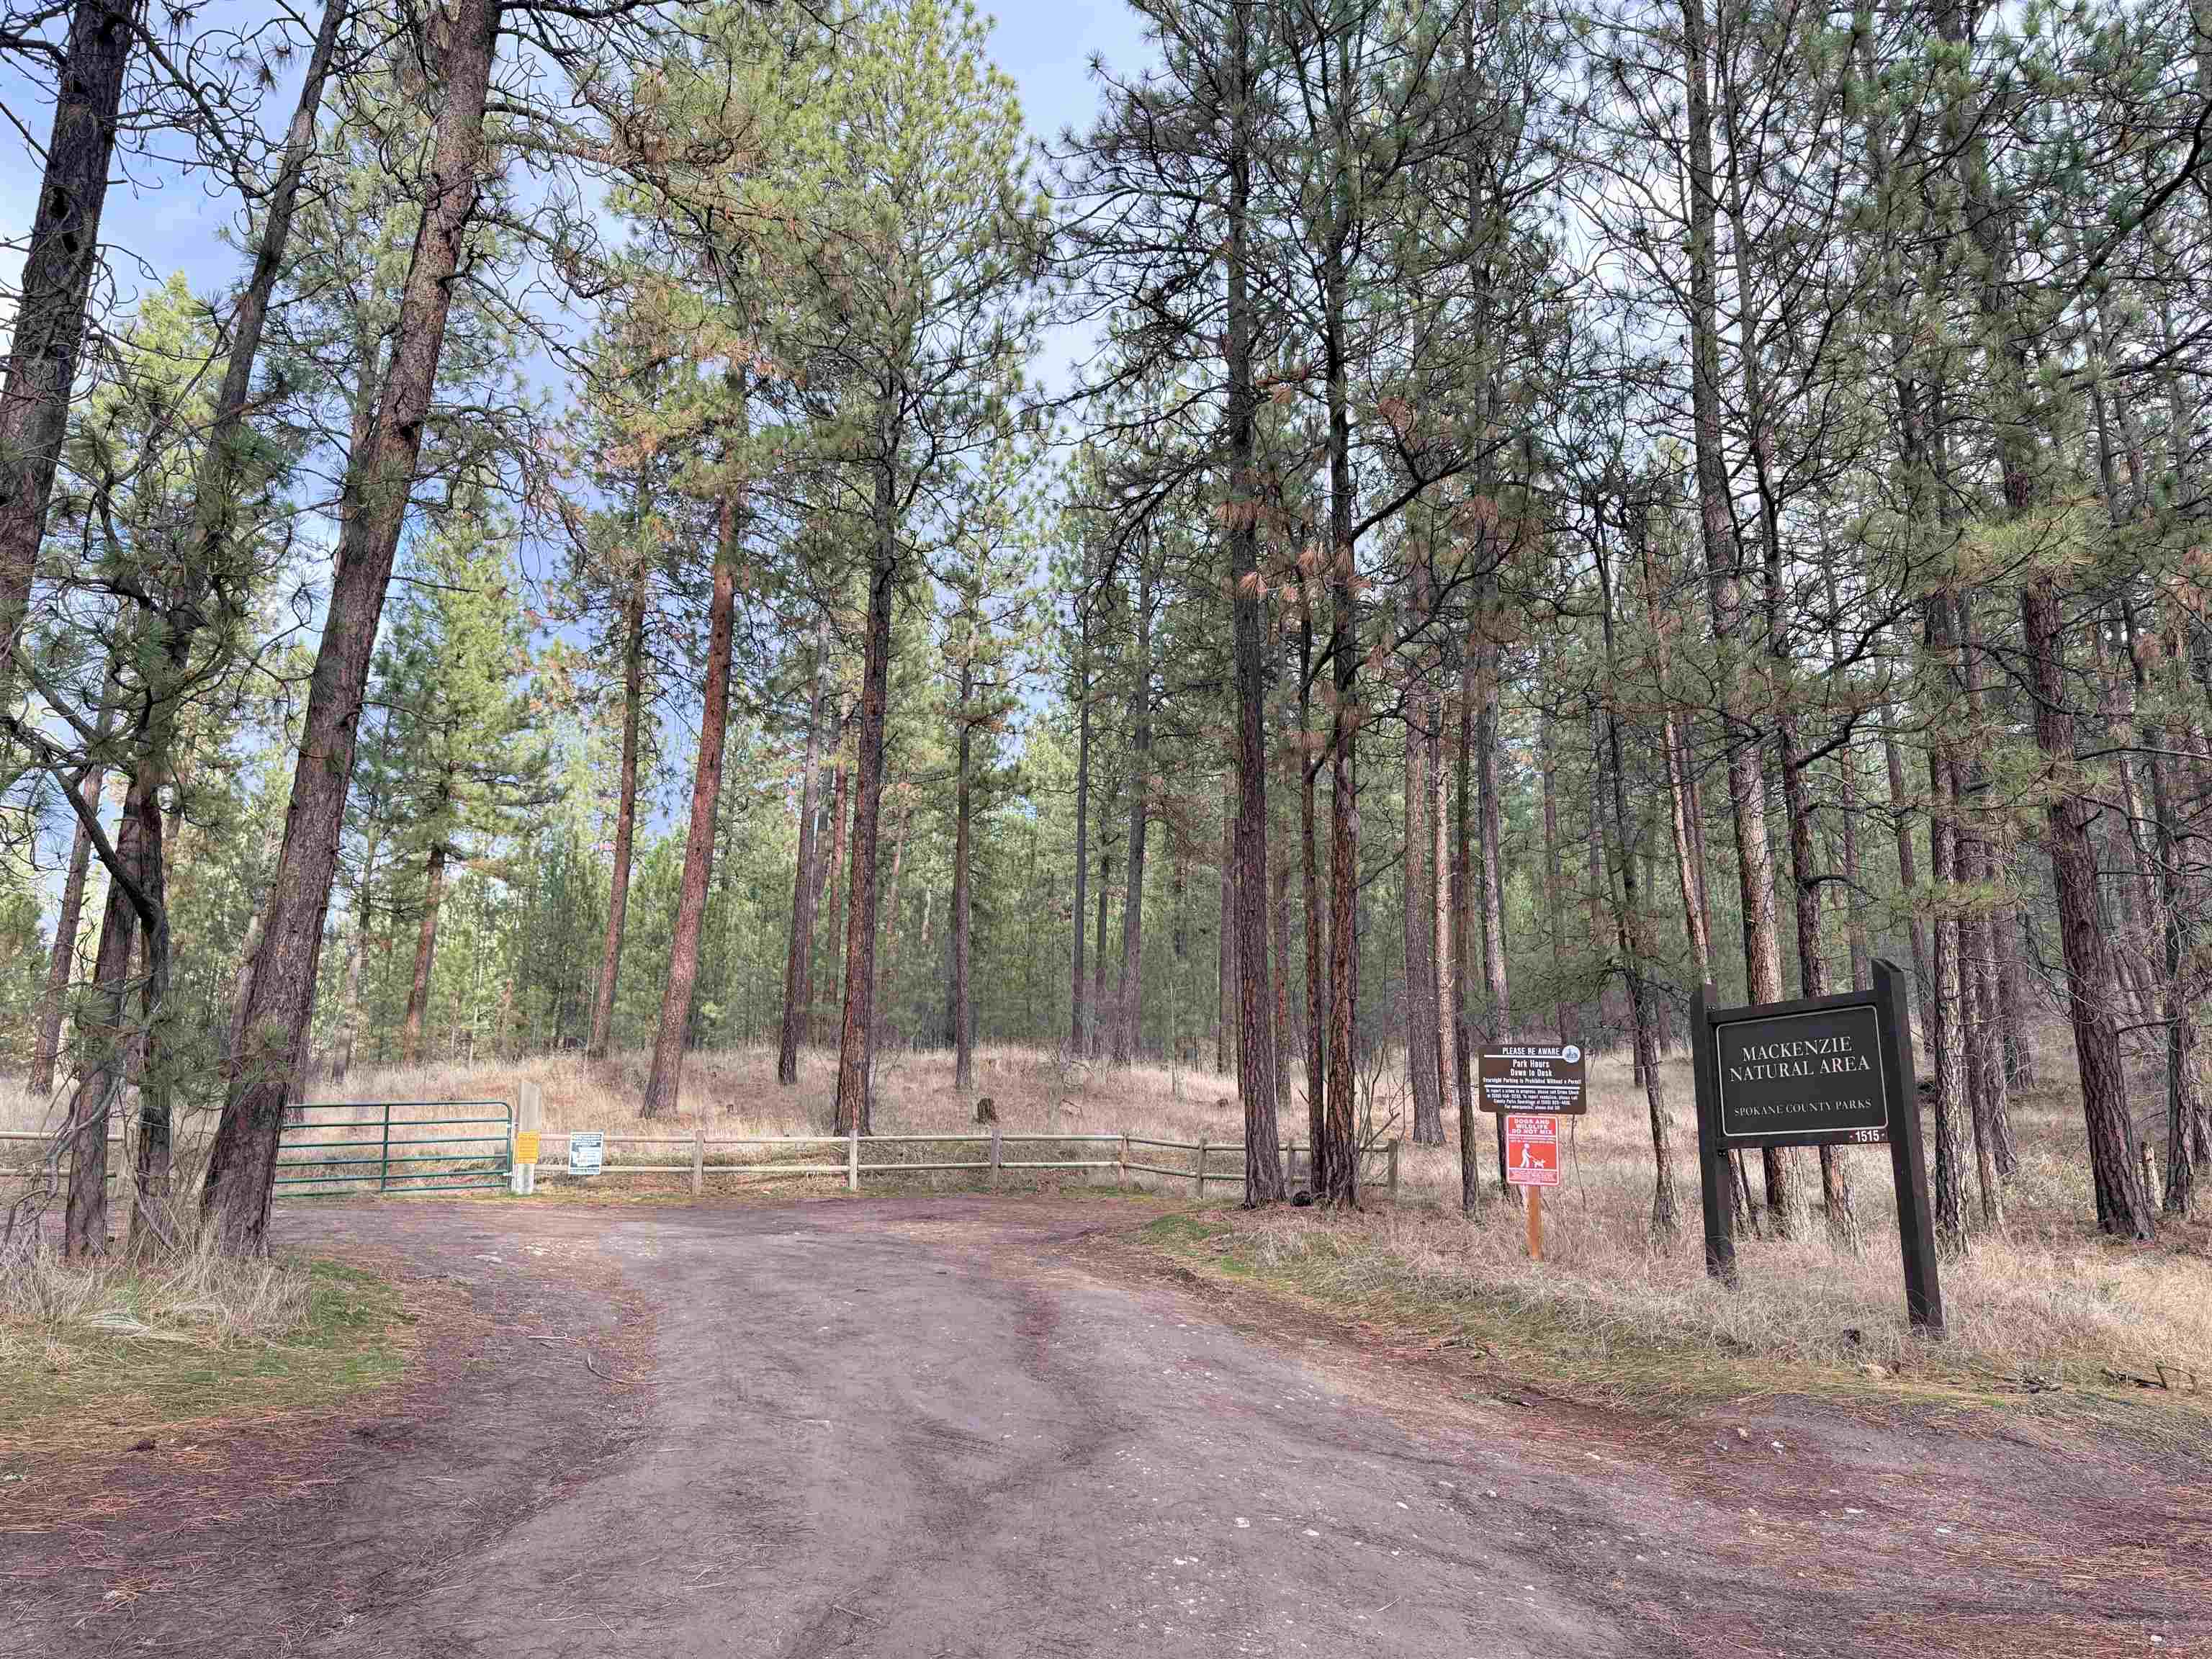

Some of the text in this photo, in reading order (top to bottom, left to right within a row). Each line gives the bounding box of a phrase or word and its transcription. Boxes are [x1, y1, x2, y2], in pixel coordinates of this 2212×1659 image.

[1742, 1037, 1853, 1061] MACKENZIE
[1513, 1059, 1527, 1068] Park
[1730, 1055, 1871, 1082] NATURAL AREA
[1734, 1099, 1872, 1116] SPOKANE COUNTY PARKS
[1856, 1130, 1879, 1142] 1515
